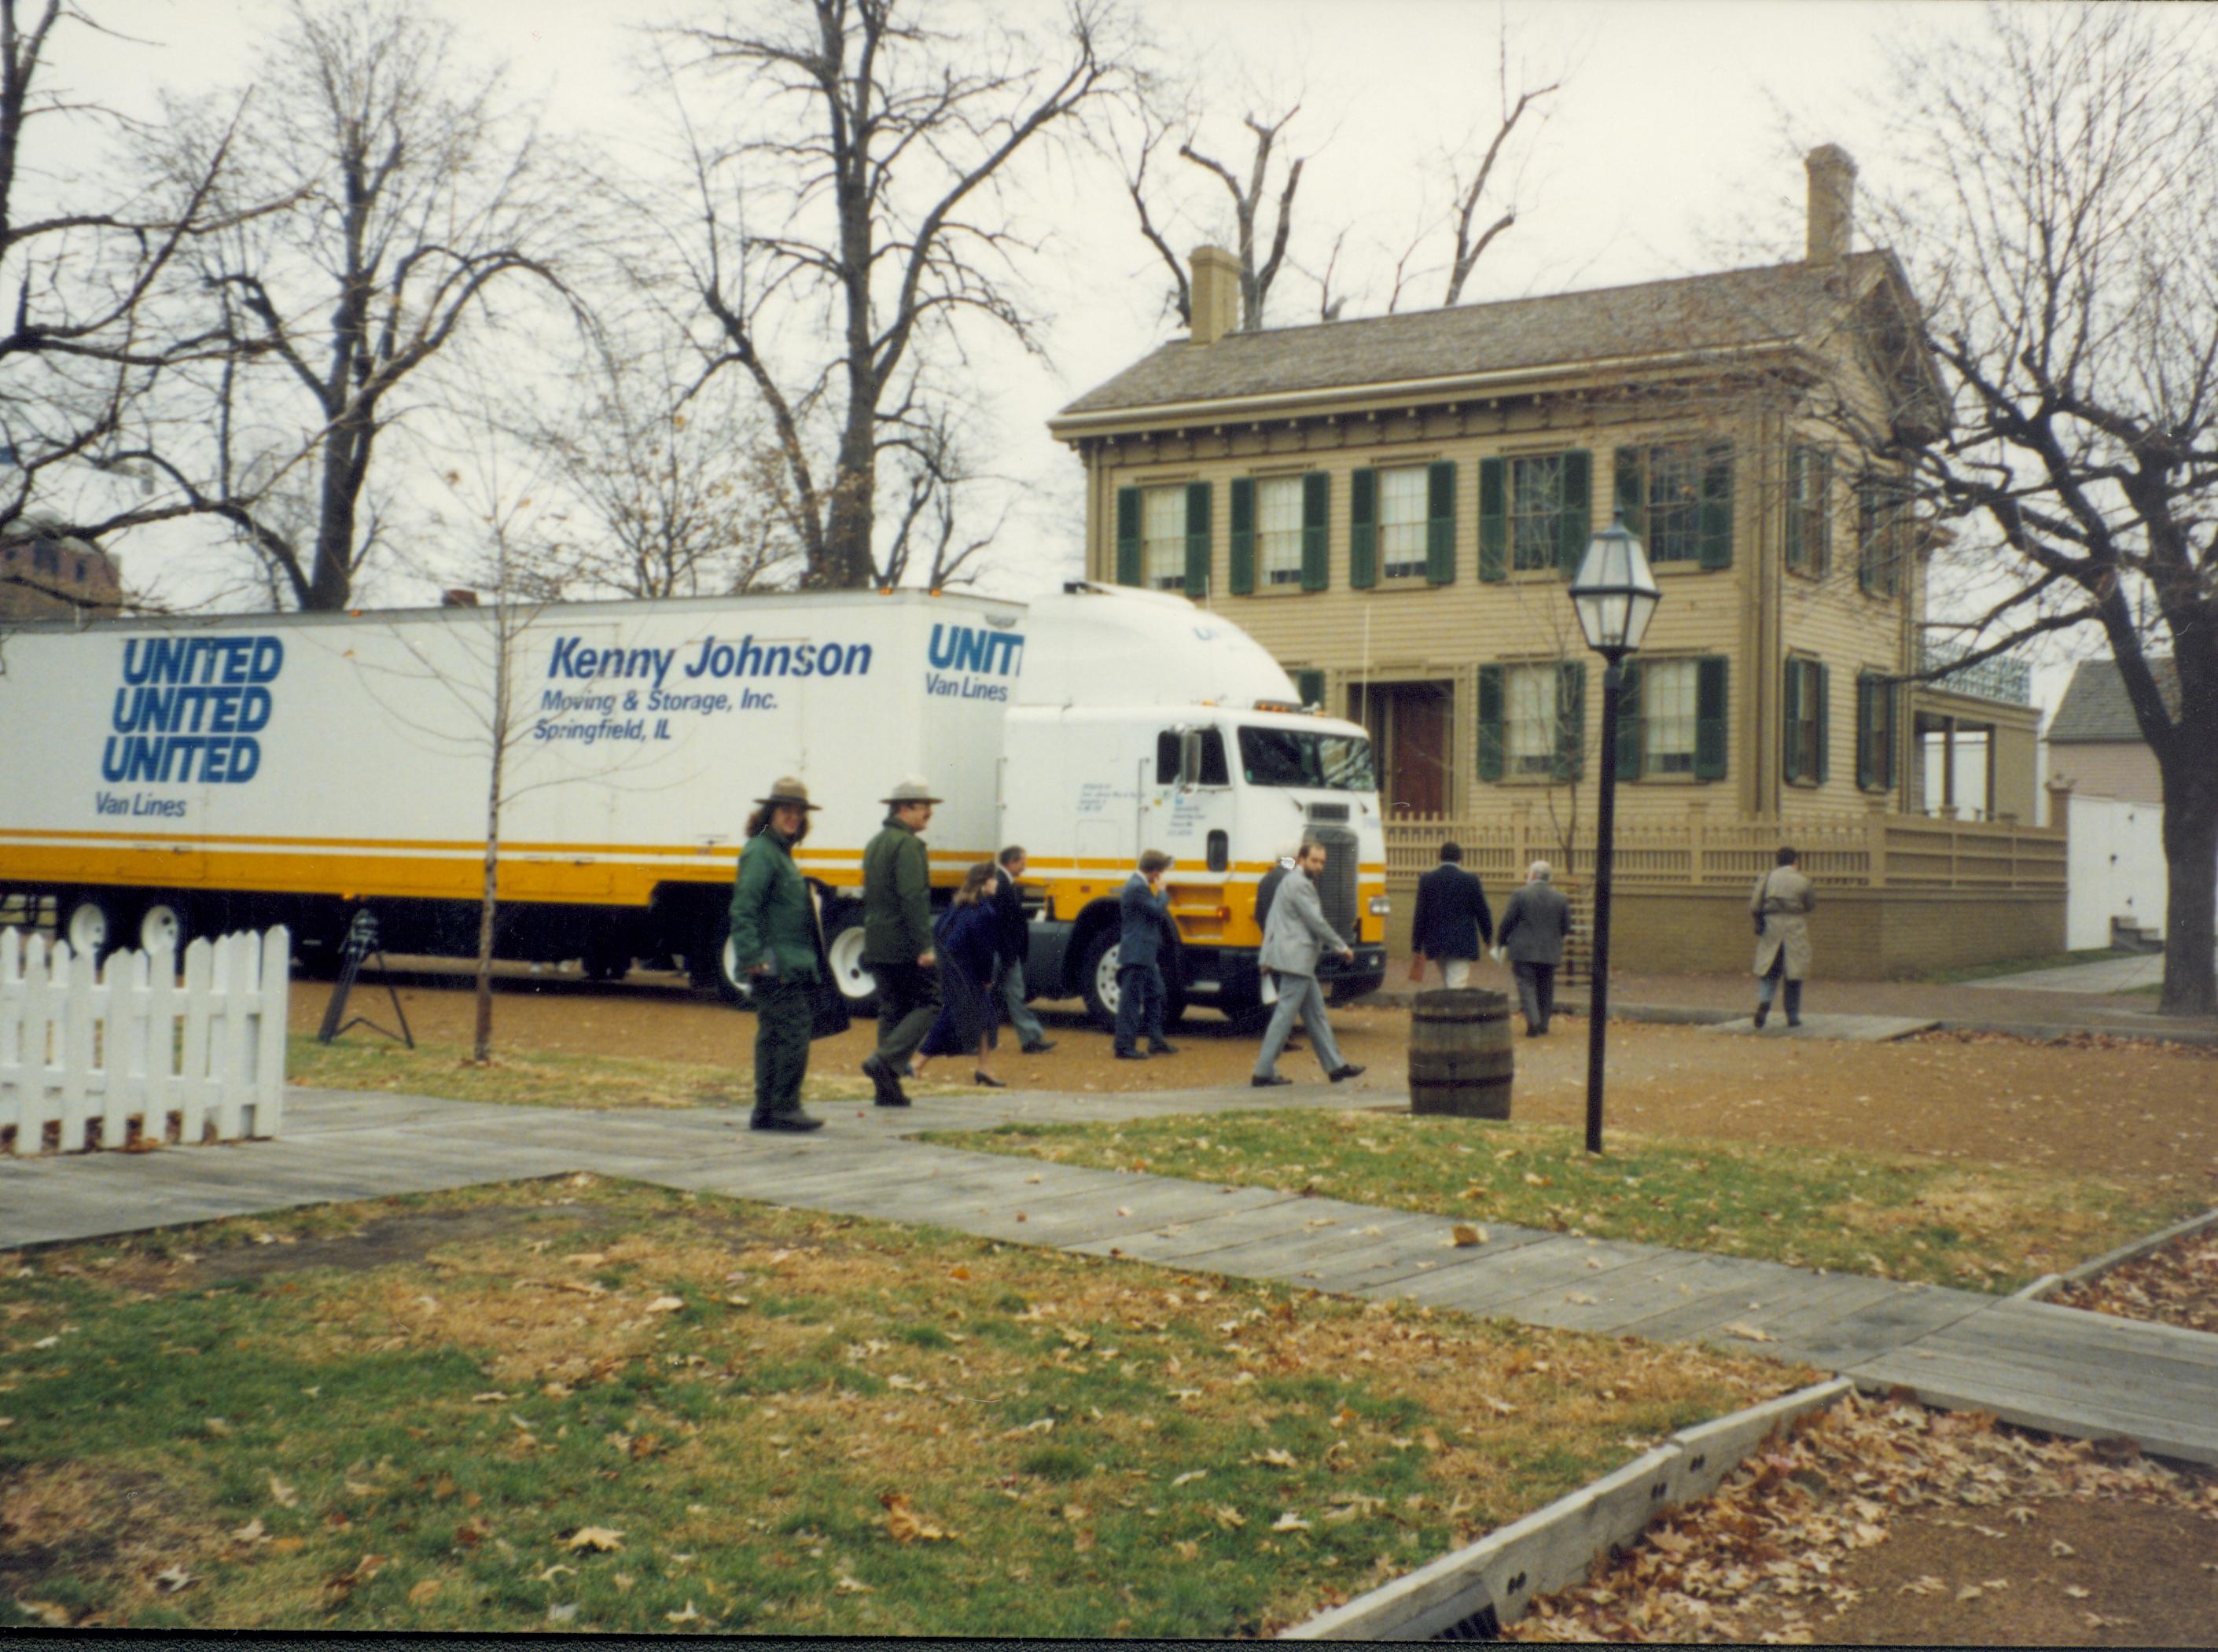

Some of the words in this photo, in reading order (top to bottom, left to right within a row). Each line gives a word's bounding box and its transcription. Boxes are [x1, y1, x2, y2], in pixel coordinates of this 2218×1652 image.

[123, 636, 285, 685] UNITED
[548, 636, 675, 689] Kenny
[685, 635, 873, 679] Johnson
[928, 624, 1024, 676] UNIT
[112, 686, 273, 734] UNITED
[541, 690, 617, 716] Moving
[623, 690, 638, 711] &
[646, 690, 734, 716] Storage,
[741, 688, 778, 710] Inc.
[925, 673, 959, 697] Van
[961, 676, 1009, 702] Lines
[533, 719, 646, 745] Springfield,
[654, 719, 672, 740] IL
[101, 735, 262, 783] UNITED
[95, 791, 130, 815] Van
[131, 793, 187, 818] Lines
